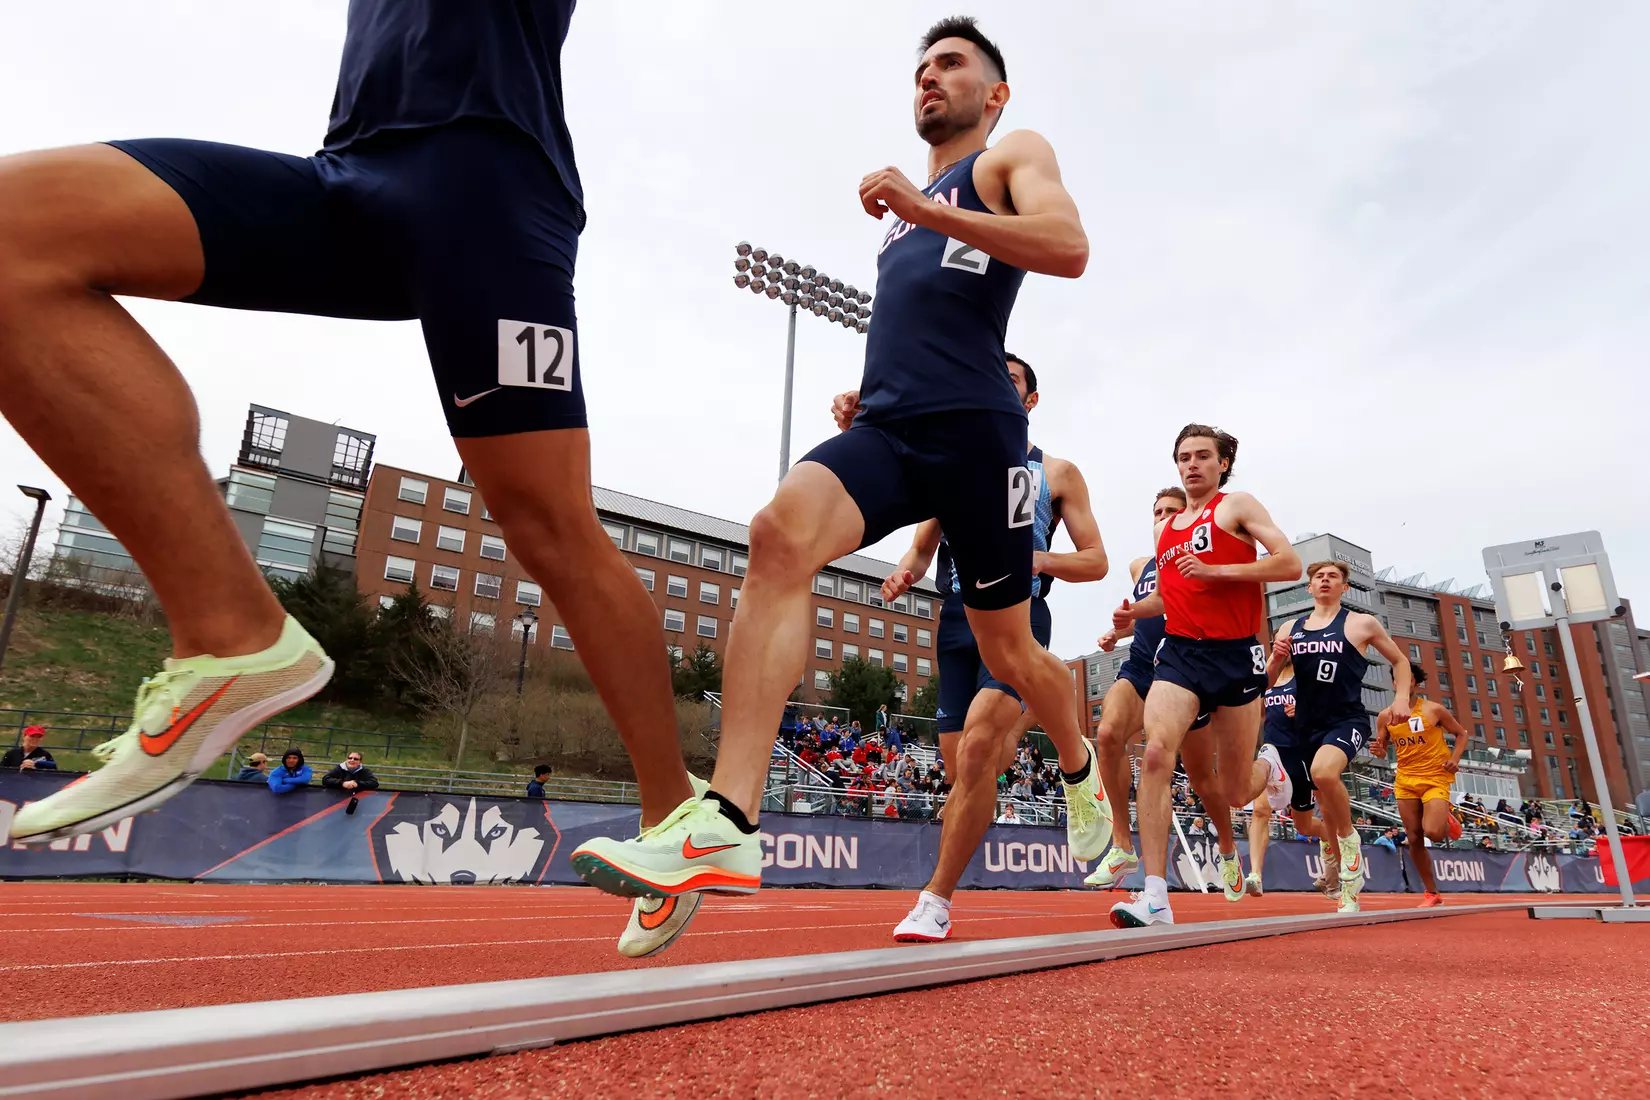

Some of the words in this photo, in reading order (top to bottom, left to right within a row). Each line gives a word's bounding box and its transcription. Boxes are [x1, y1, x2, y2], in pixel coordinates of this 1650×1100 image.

[515, 326, 565, 386] 12
[1012, 470, 1031, 523] 2
[1194, 525, 1209, 551] 3
[1254, 647, 1265, 672] 3
[1291, 641, 1343, 655] UCONN
[1319, 662, 1334, 680] 9
[1410, 718, 1419, 731] 7
[760, 832, 858, 869] CONN
[1433, 860, 1485, 881] UCONN
